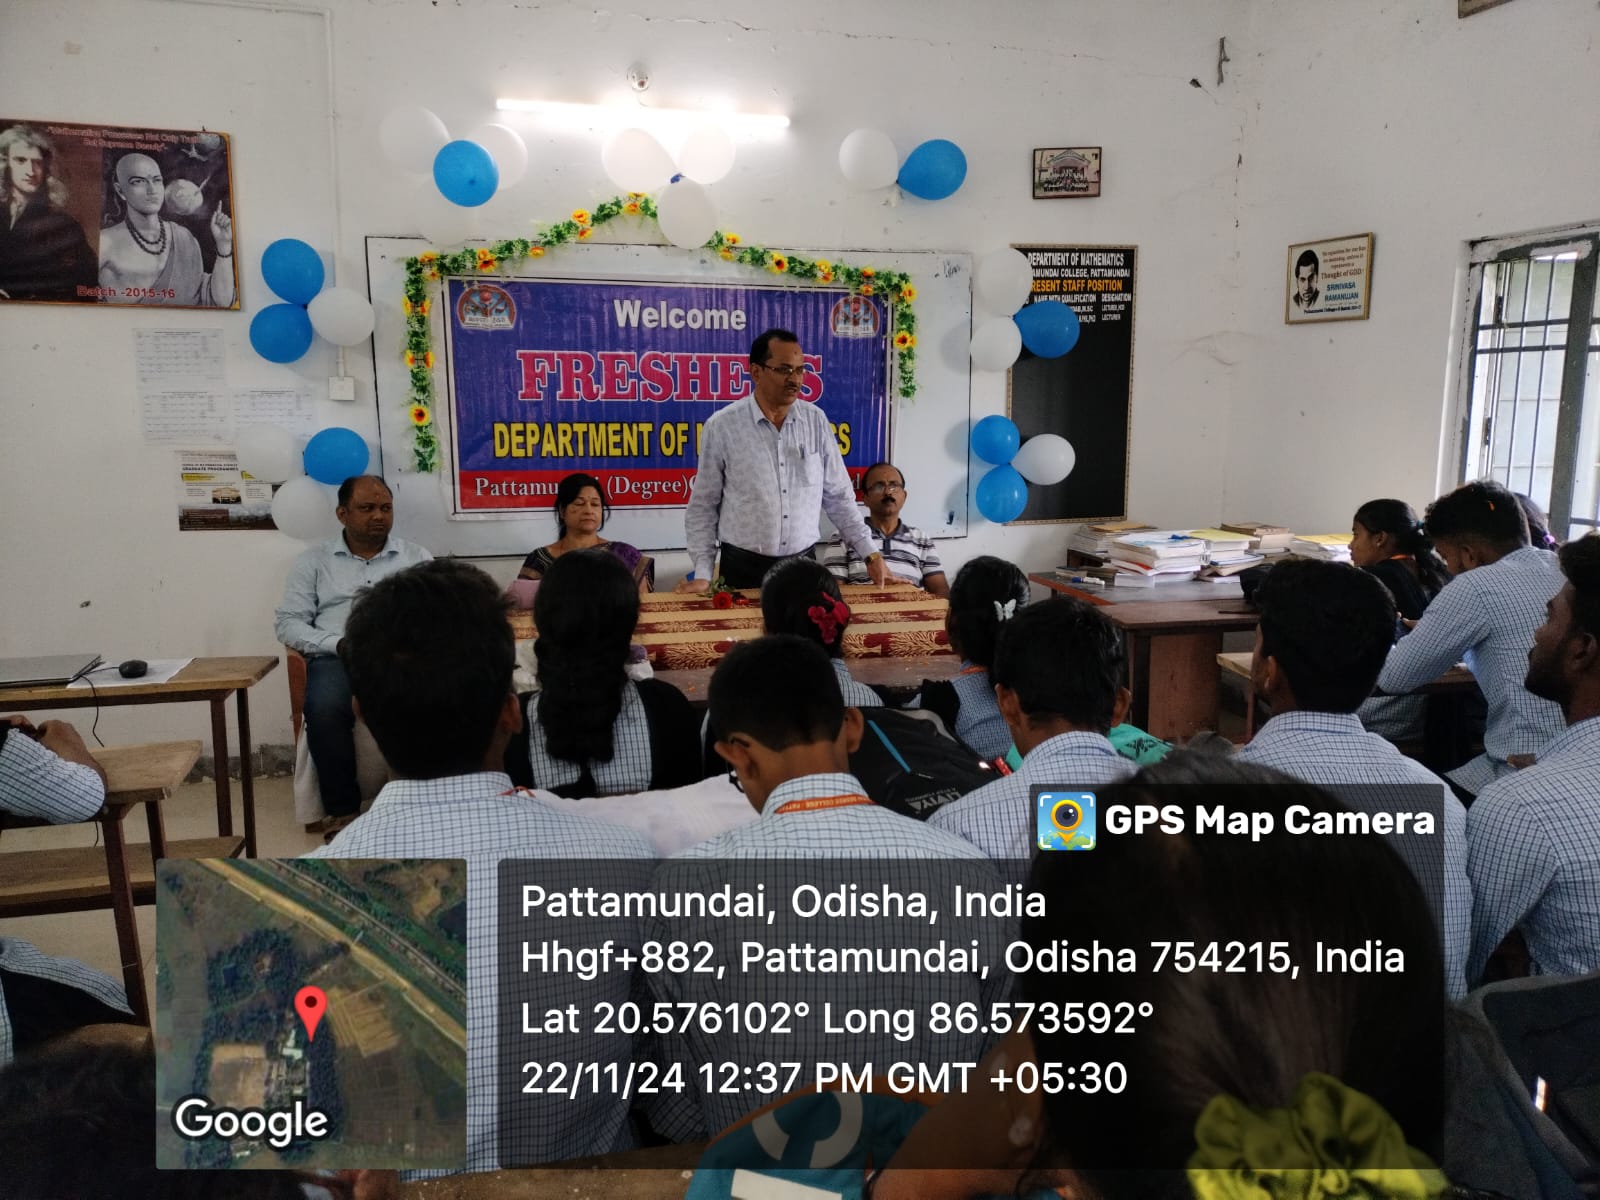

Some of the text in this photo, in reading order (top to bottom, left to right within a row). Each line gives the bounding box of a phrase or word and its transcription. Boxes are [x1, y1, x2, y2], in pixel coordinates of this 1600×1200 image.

[1028, 252, 1124, 266] DEPARTMENT OF MATHEMATICS
[1032, 268, 1130, 279] AMUNDAI COLLEGE, PATTAMUNDAI
[76, 285, 117, 297] Batch
[1031, 279, 1123, 292] RESENT STAFF POSITION
[1326, 281, 1356, 291] SRINIVASA
[1324, 292, 1359, 301] RAMANUJAN
[613, 299, 746, 330] Welcome
[516, 350, 824, 403] FRESHES
[493, 422, 653, 458] DEPARTMENT
[660, 422, 689, 457] OF
